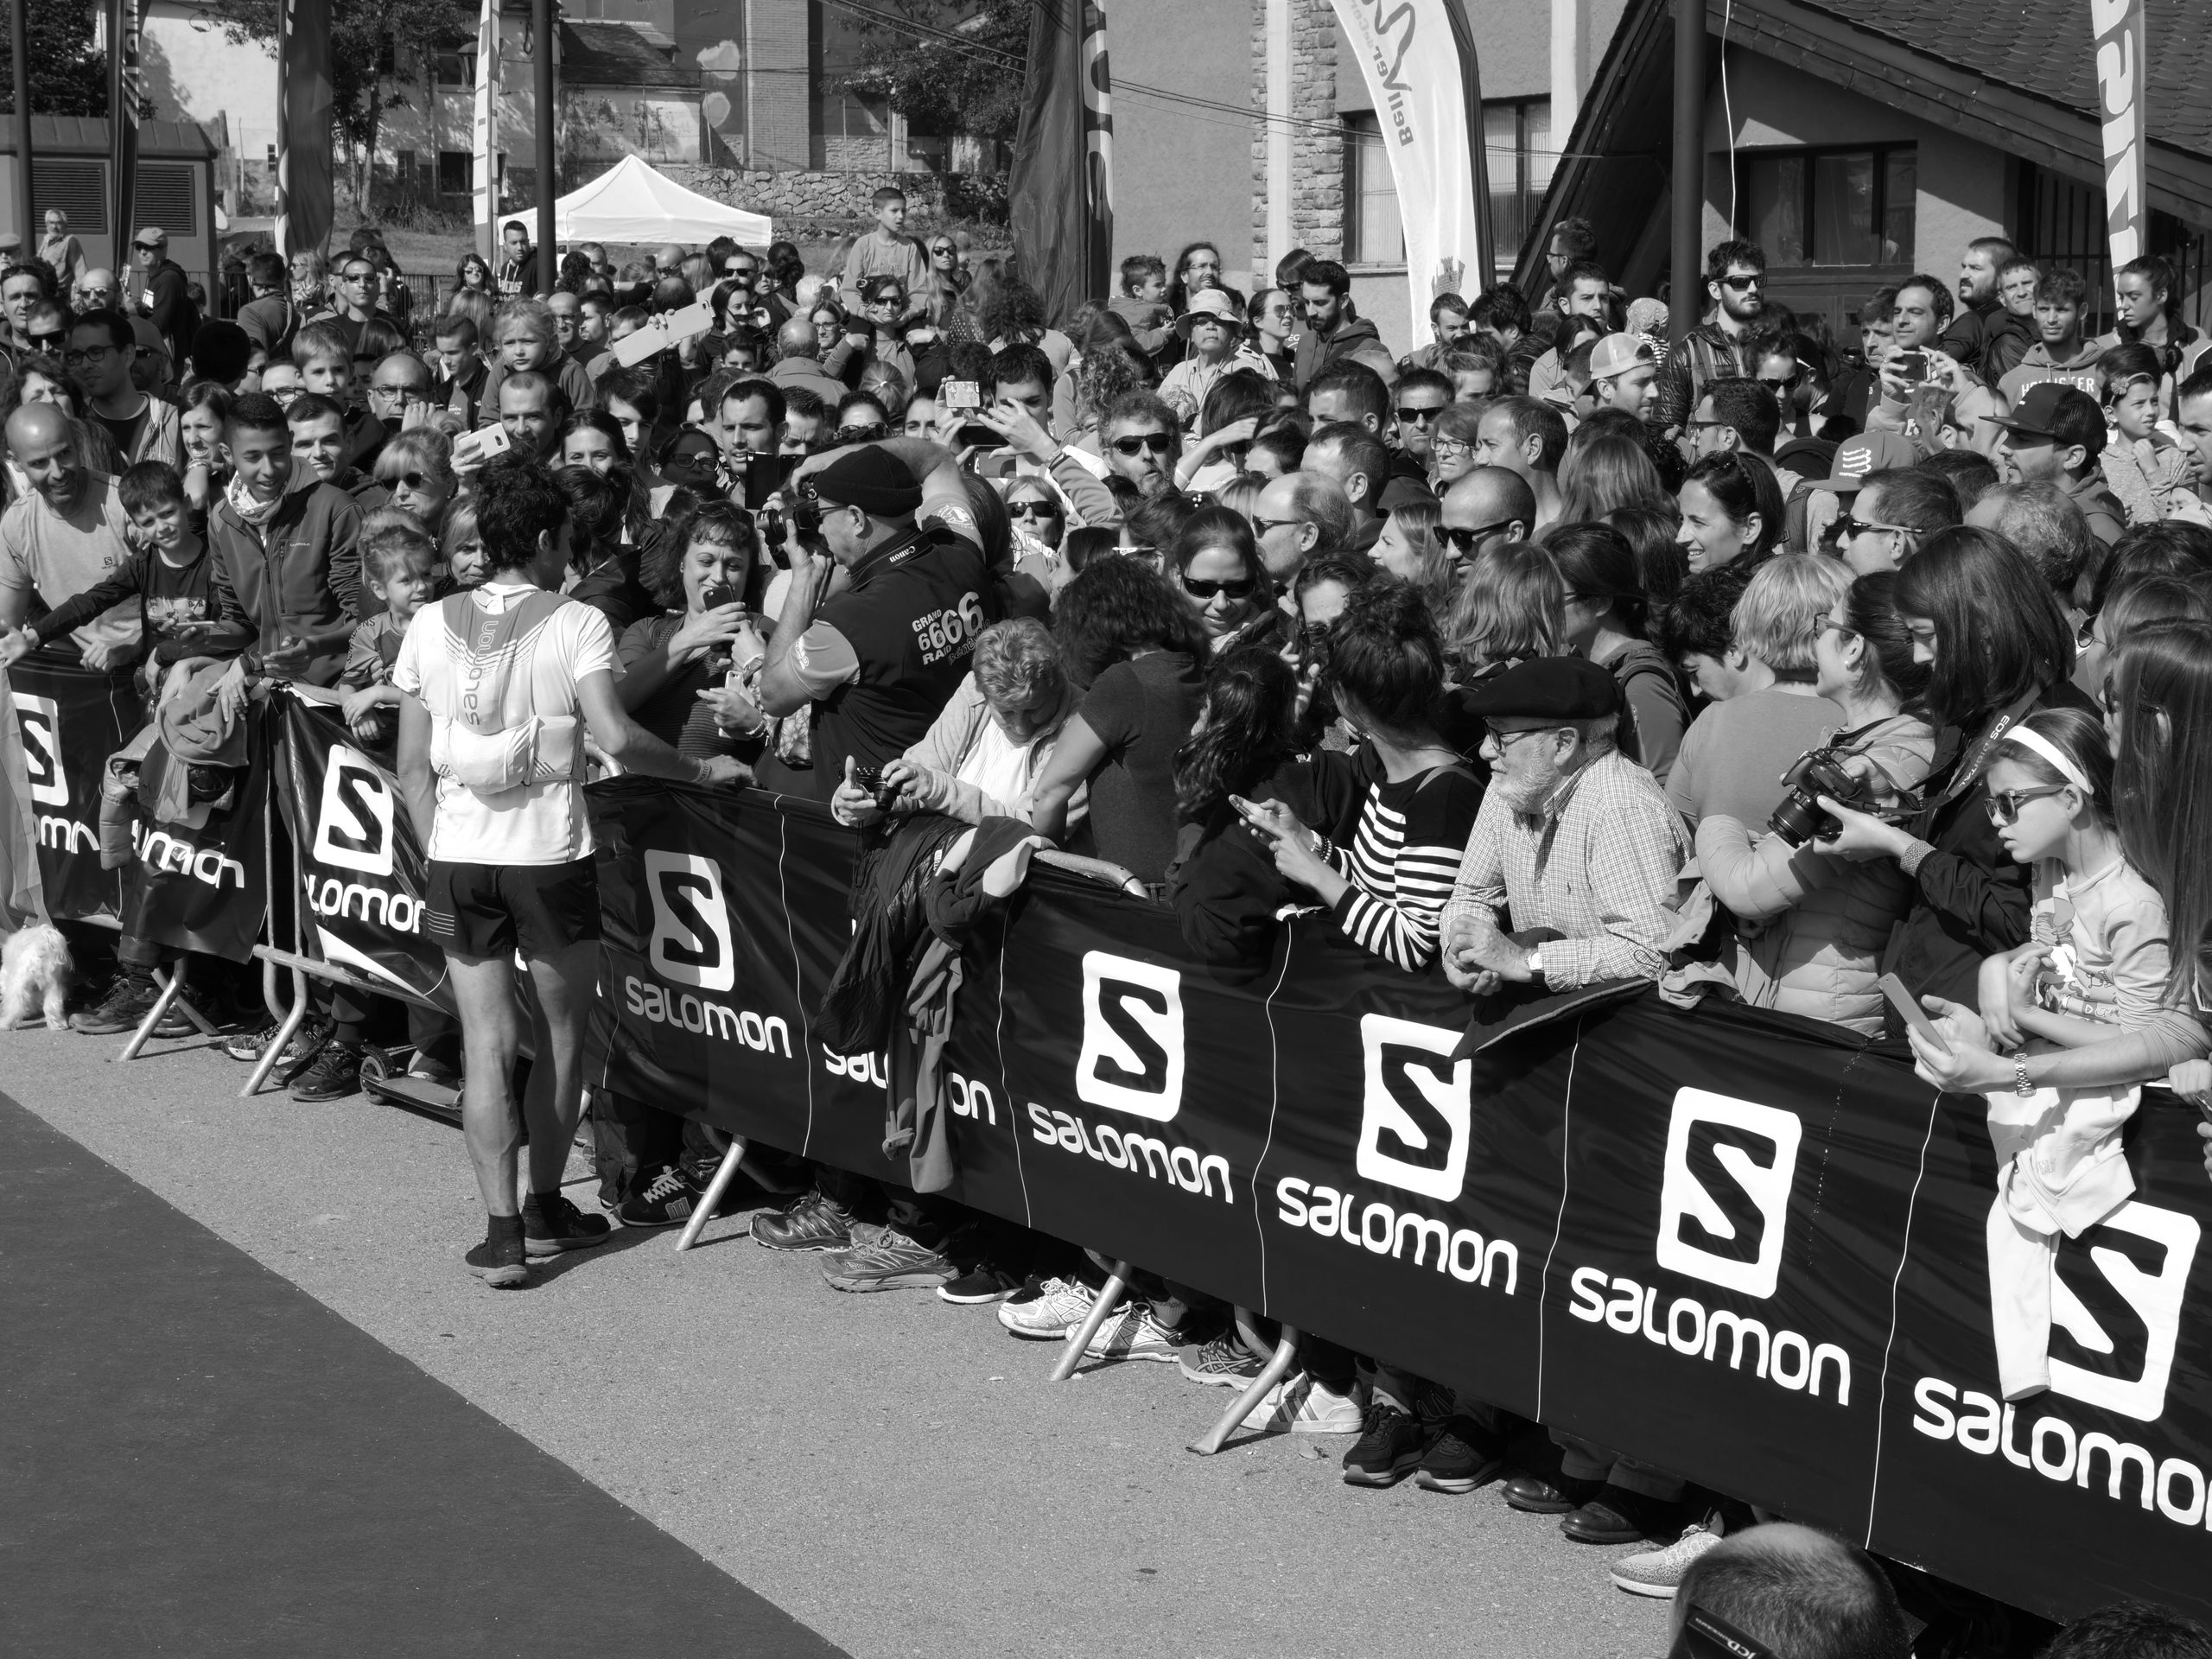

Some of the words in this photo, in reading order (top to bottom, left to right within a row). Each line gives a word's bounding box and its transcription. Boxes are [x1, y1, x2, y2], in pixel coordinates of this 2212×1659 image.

[889, 545, 916, 563] Canon
[912, 608, 942, 632] GRAND
[918, 591, 984, 652] 6666
[922, 645, 952, 665] RAID
[1989, 714, 2011, 741] EOS
[1913, 1376, 2212, 1532] salomo
